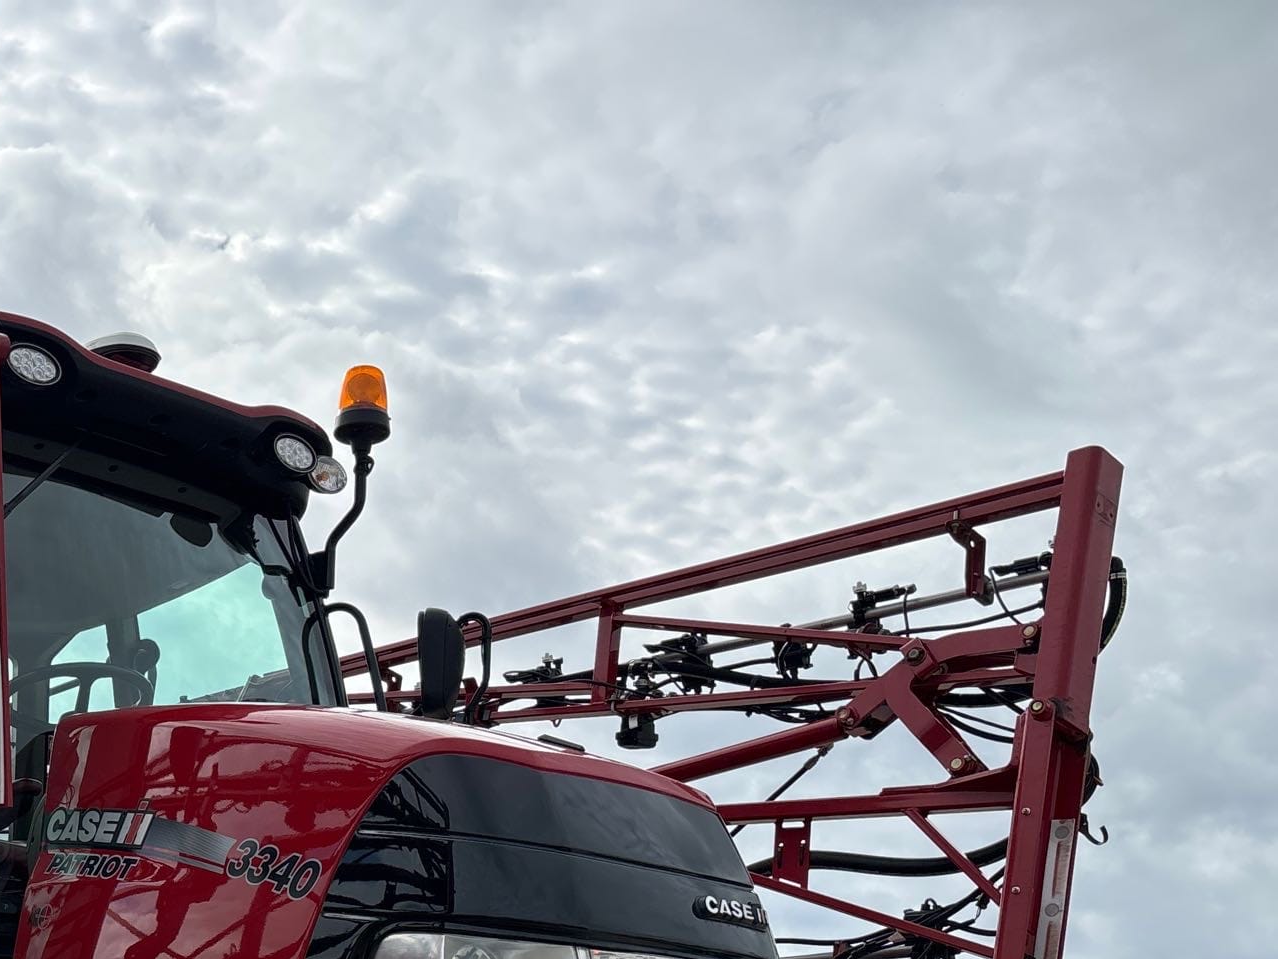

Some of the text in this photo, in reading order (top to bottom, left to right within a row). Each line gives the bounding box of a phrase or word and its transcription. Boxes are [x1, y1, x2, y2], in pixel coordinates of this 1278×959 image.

[46, 808, 122, 844] CASE
[44, 852, 140, 881] PATRIOT
[226, 838, 322, 900] 3340
[705, 895, 754, 920] CASE
